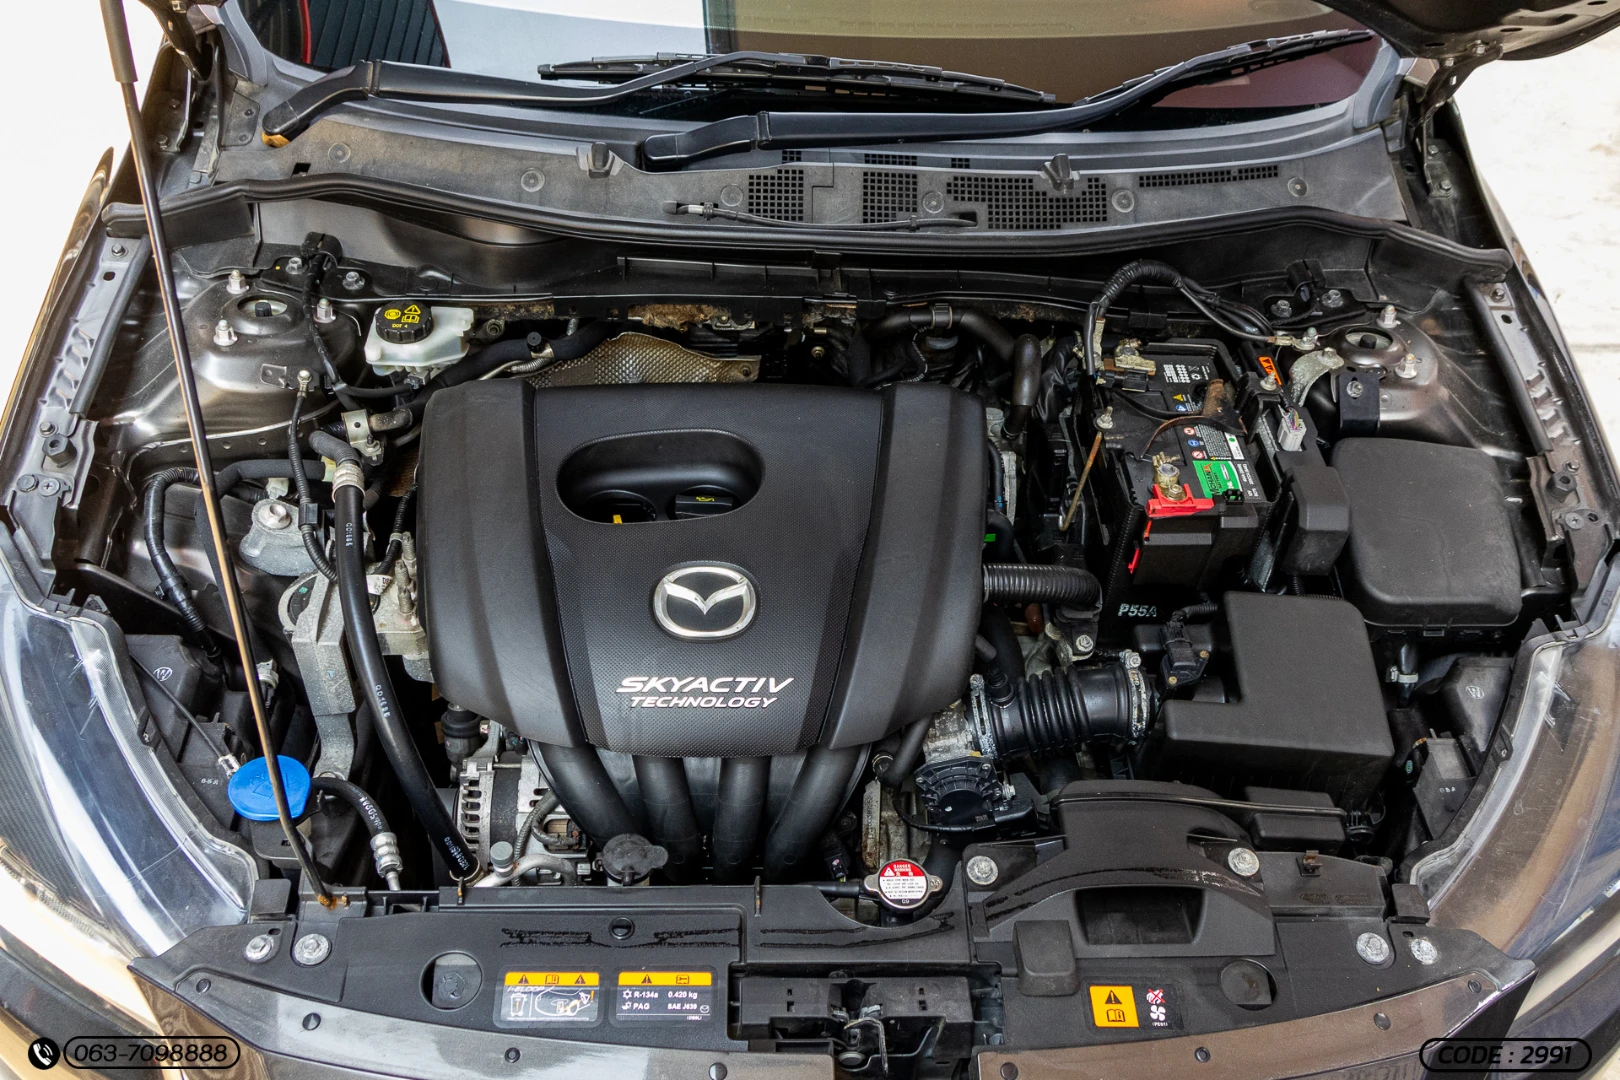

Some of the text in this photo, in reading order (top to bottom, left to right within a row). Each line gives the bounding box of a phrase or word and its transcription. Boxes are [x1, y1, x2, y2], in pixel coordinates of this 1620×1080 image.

[1117, 603, 1157, 617] P55A
[616, 676, 794, 693] SKYACTIV
[630, 696, 778, 708] TECHNOLOGY
[688, 991, 698, 999] kg
